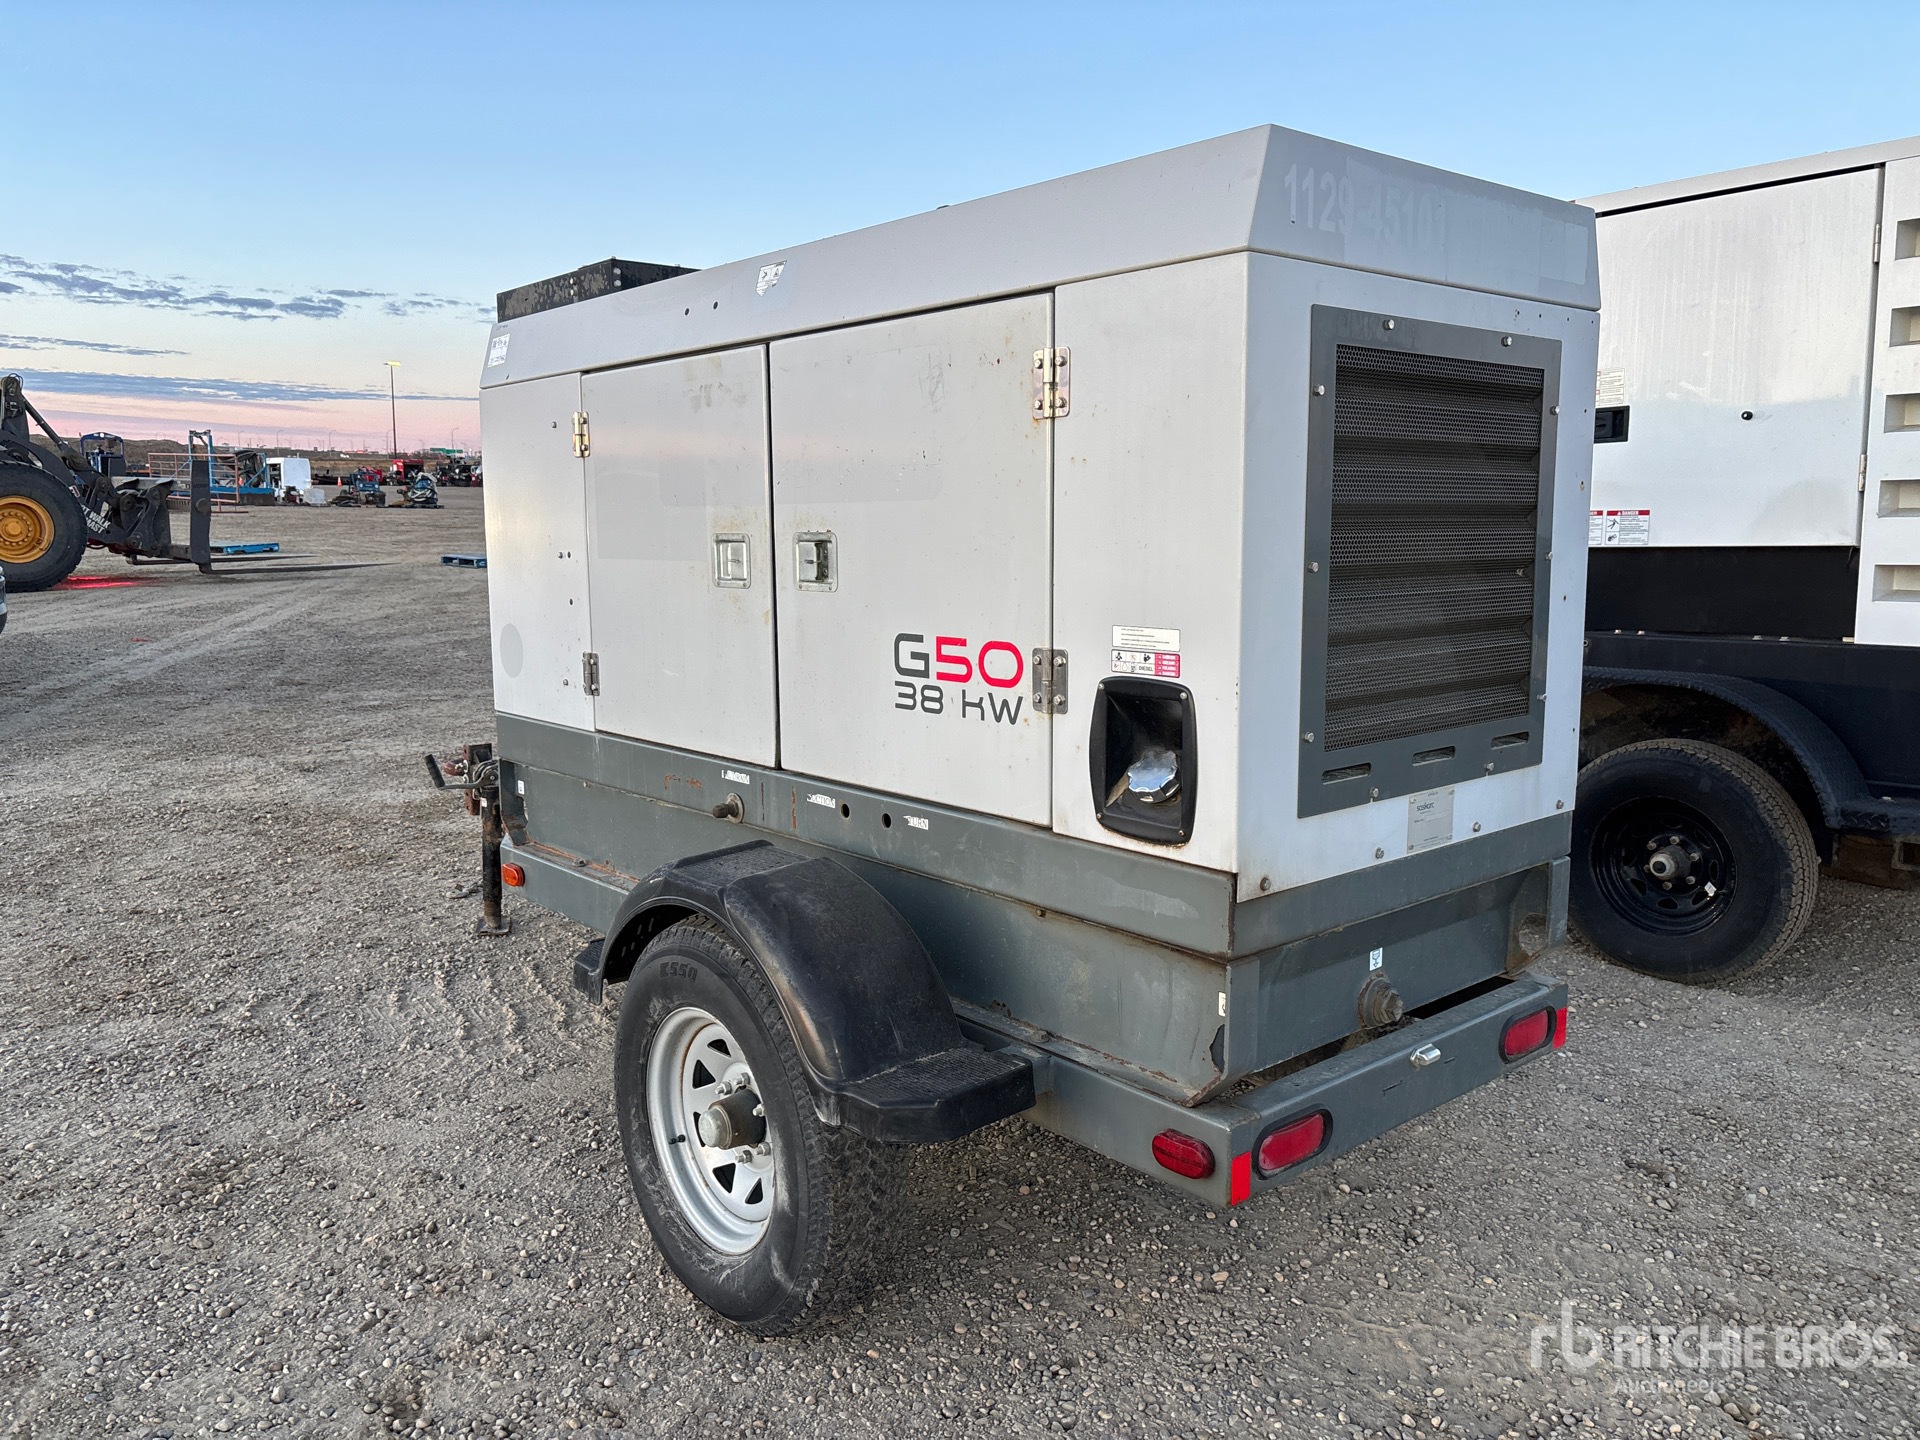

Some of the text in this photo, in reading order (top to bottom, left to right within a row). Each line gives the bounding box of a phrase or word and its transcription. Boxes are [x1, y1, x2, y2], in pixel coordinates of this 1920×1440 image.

[89, 511, 111, 529] WALK
[894, 632, 1024, 689] G50
[894, 680, 944, 715] 38
